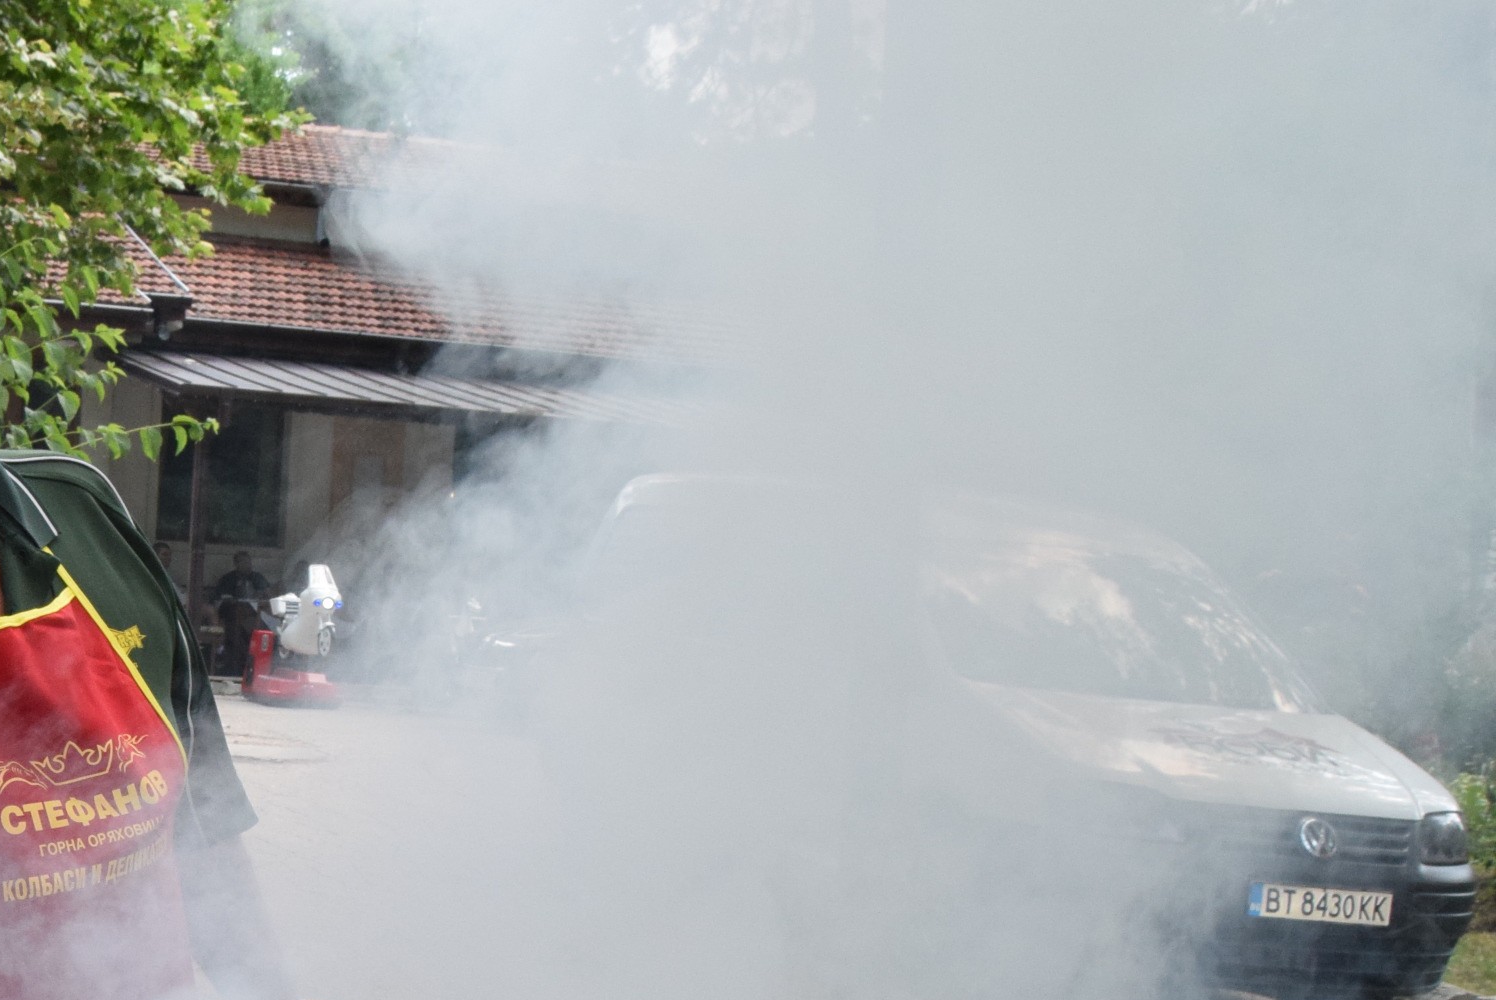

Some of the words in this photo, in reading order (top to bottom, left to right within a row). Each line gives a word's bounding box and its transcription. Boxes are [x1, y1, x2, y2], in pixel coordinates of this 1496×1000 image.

[0, 769, 169, 835] СТЕФАНОВ
[38, 839, 86, 857] ГОРНА
[2, 866, 86, 902] КОЛБАСИ
[1265, 888, 1297, 914] BT
[1301, 890, 1356, 919] 8430
[1358, 896, 1389, 922] KK
